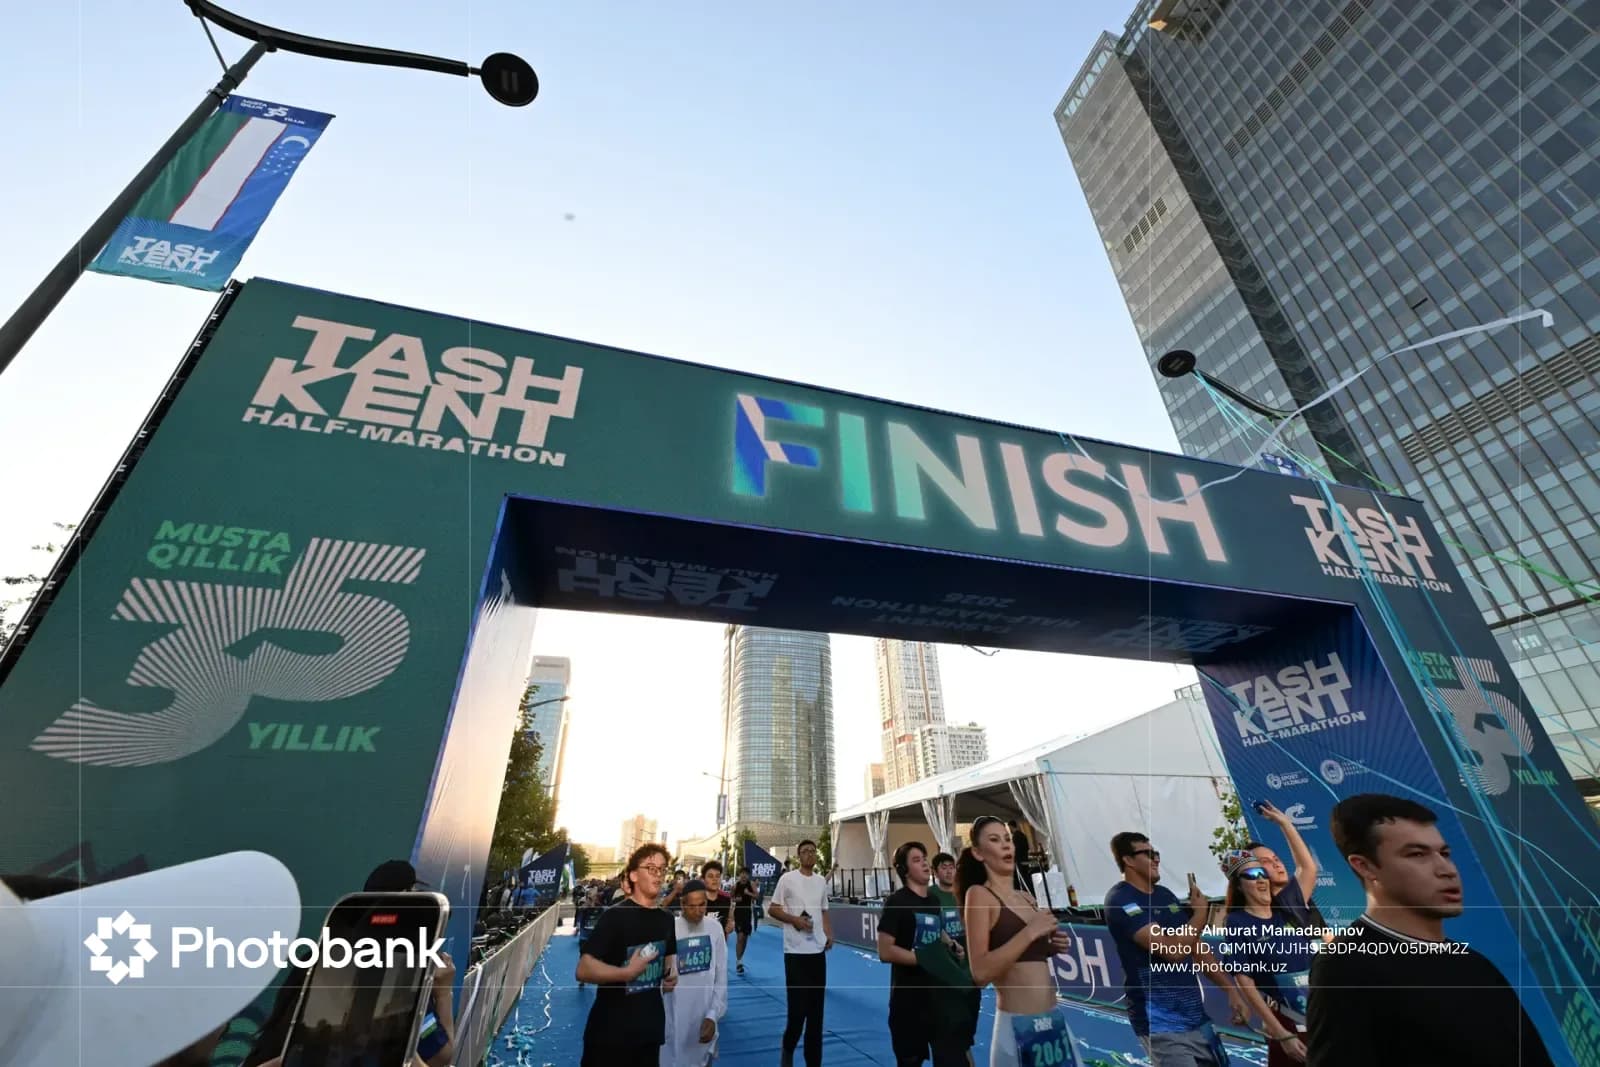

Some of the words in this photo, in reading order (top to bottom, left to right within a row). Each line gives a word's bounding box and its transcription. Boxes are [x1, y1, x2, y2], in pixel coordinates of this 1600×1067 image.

[119, 246, 212, 271] KENT
[133, 235, 220, 264] TASH
[292, 315, 584, 419] TASH
[251, 357, 574, 448] KENT
[242, 407, 567, 467] HALF-MARATHON
[731, 393, 1228, 563] FINISH
[153, 519, 292, 553] MUSTA
[1289, 494, 1433, 557] TASH
[146, 543, 289, 575] QILLIK
[1304, 526, 1438, 580] KENT
[1320, 563, 1453, 593] HALFMARATHON
[28, 537, 427, 767] 35
[1225, 651, 1352, 709] TASH
[247, 721, 382, 753] YILLIK
[1233, 687, 1352, 738] KENT
